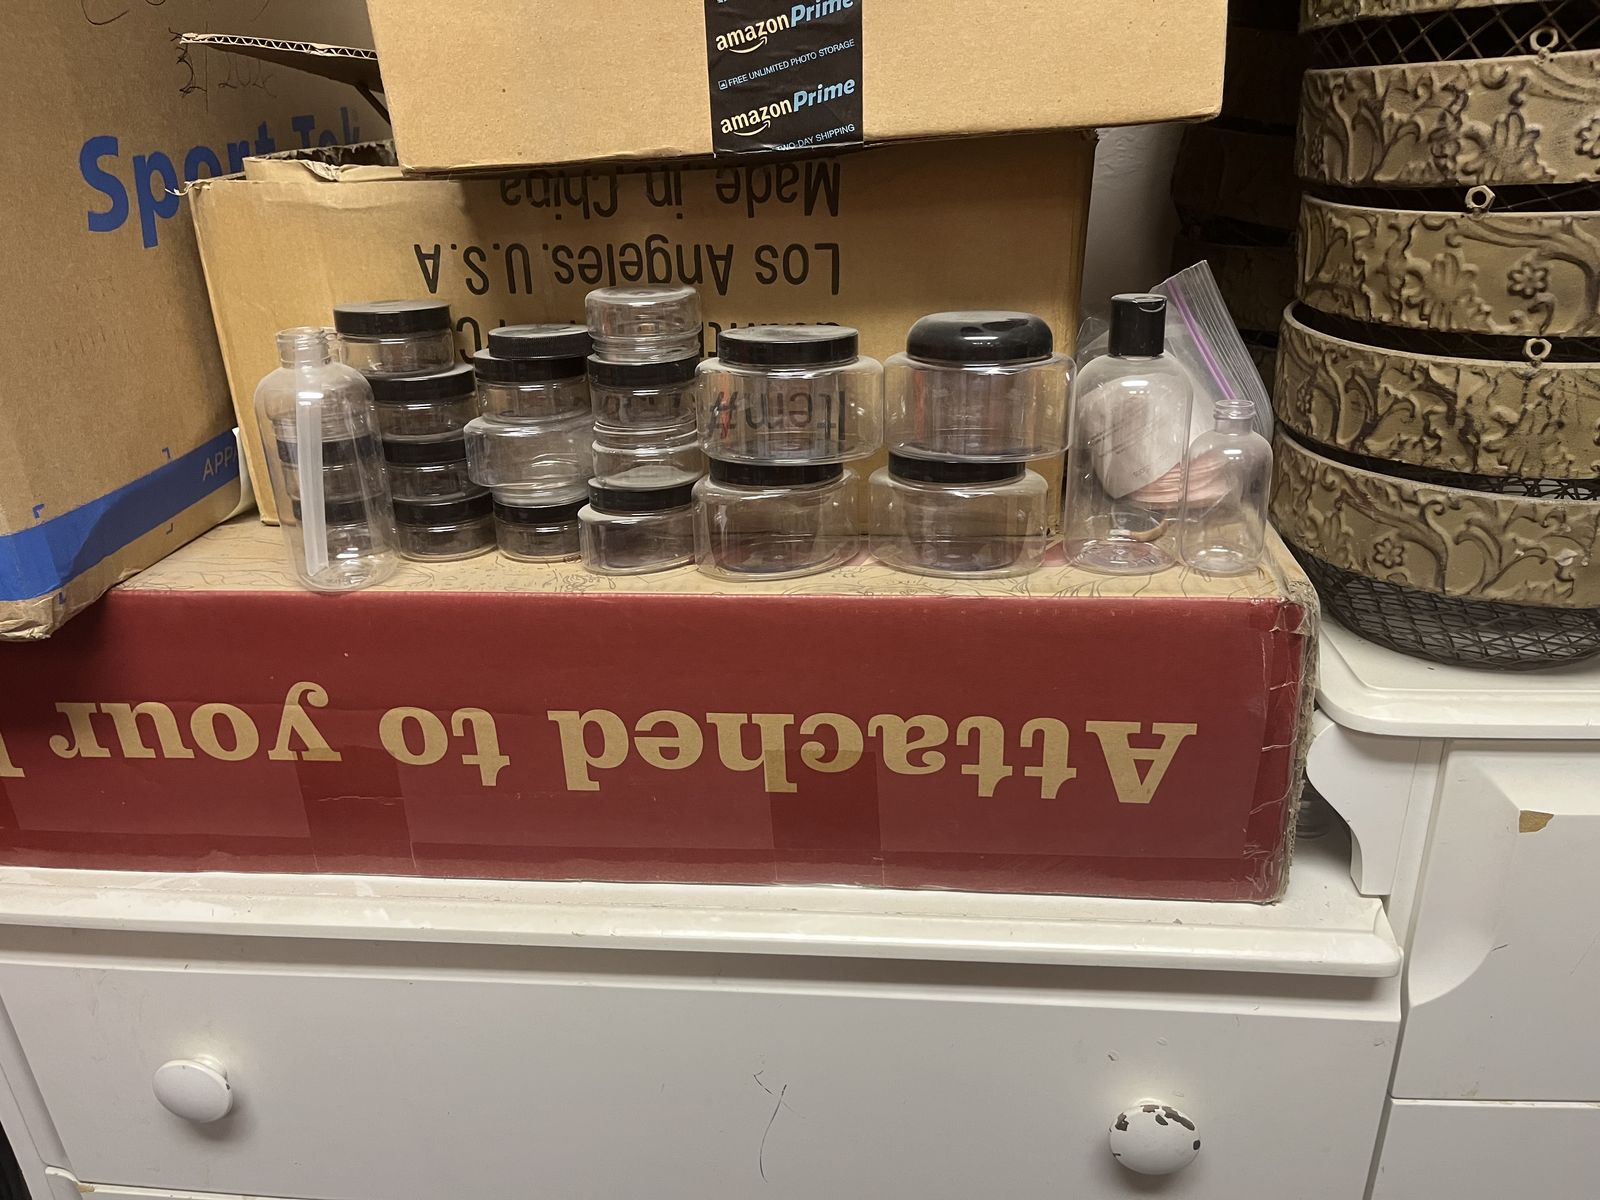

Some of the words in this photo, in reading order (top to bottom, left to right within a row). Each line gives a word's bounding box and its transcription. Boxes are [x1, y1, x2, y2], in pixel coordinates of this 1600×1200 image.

[728, 73, 749, 87] FREE
[748, 60, 790, 80] UNLIMITED
[790, 51, 817, 67] PHOTO
[818, 38, 856, 57] STORAGE
[815, 123, 856, 142] SHIPPING
[499, 173, 619, 221] China
[646, 171, 683, 218] in
[716, 162, 841, 218] Made
[413, 243, 533, 296] U.S.A
[755, 243, 840, 296] Los
[52, 680, 341, 770] your
[376, 705, 508, 789] to
[547, 707, 1198, 806] Attached
